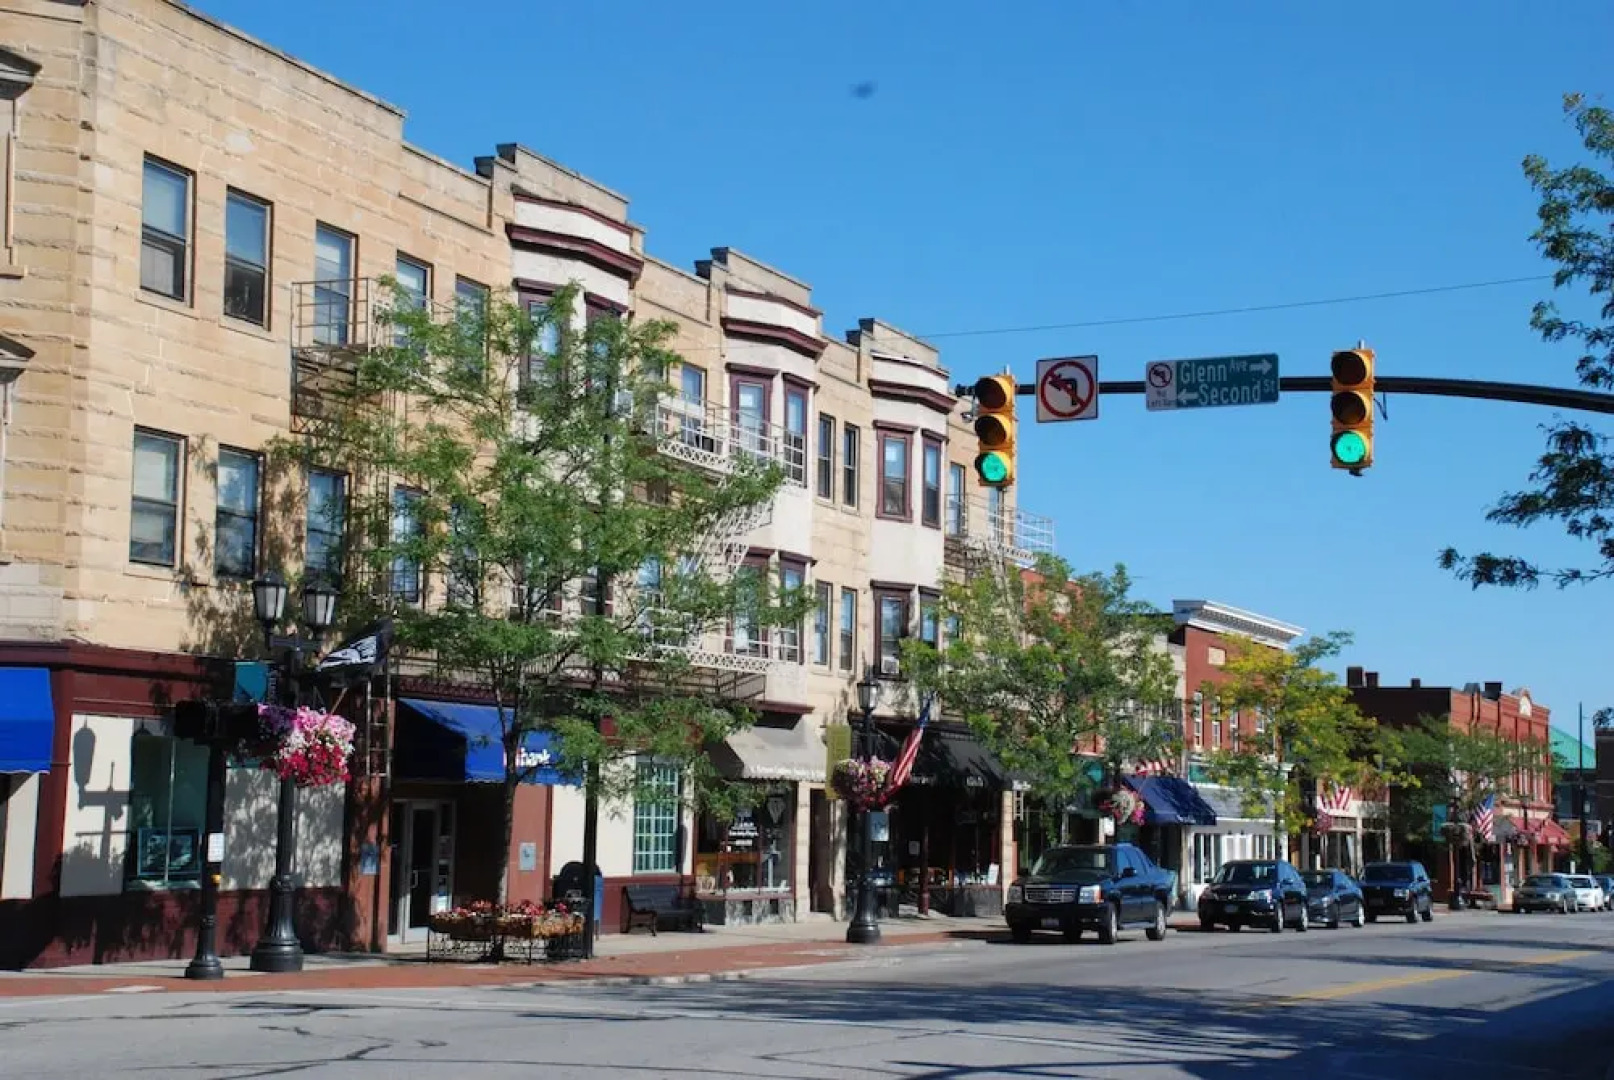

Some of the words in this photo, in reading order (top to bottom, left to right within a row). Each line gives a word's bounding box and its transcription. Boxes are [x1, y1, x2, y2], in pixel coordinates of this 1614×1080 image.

[1181, 361, 1227, 384] Glenn
[1229, 360, 1248, 373] Ave
[1199, 381, 1260, 405] Second
[1263, 379, 1275, 392] St
